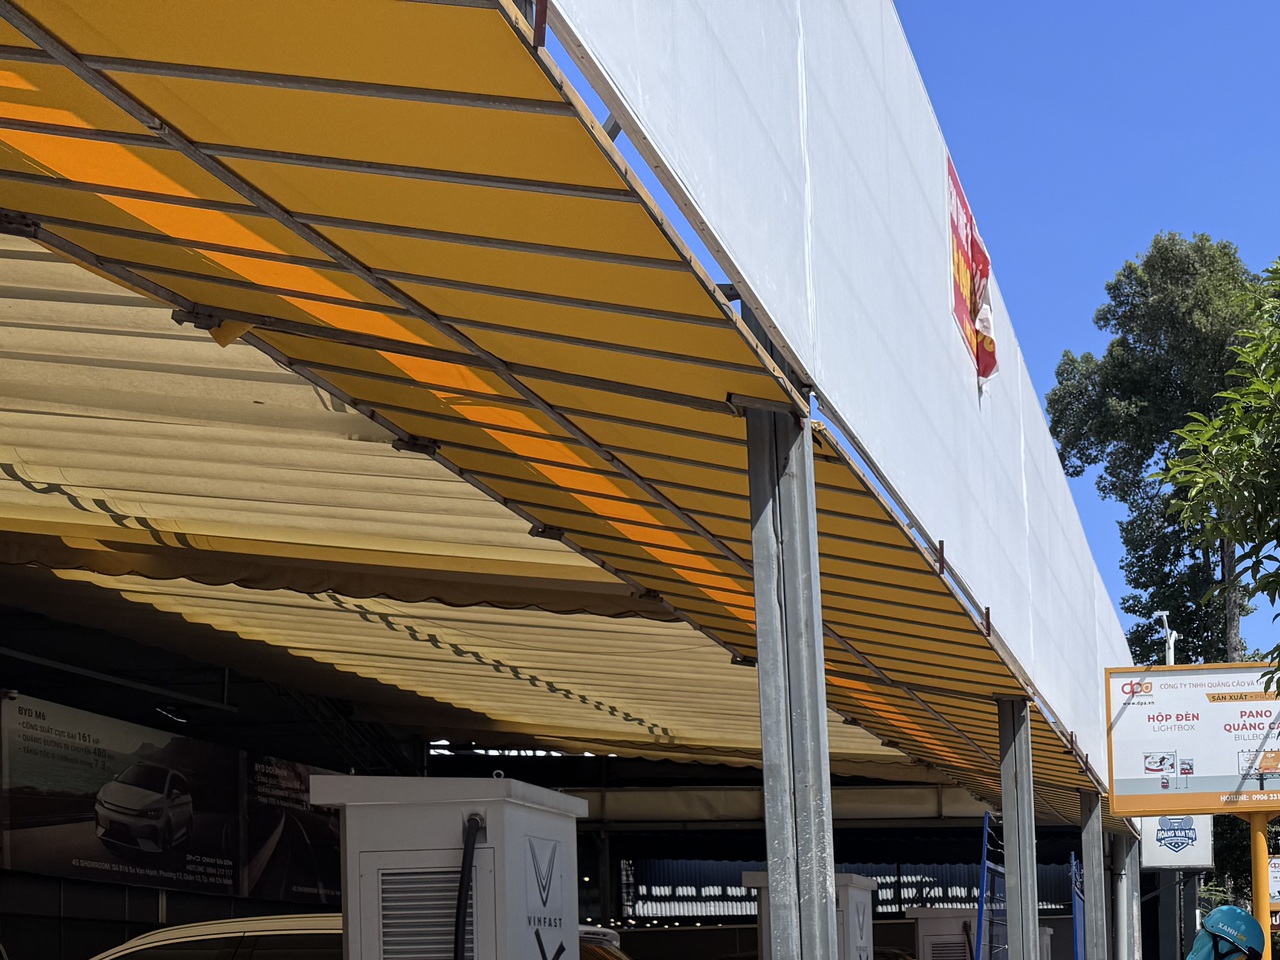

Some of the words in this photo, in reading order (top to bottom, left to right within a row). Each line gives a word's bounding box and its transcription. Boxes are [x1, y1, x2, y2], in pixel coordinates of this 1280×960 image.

[1121, 680, 1152, 698] dpa
[1160, 681, 1178, 690] CÔNG
[1207, 680, 1230, 689] QUẢNG
[1212, 692, 1226, 702] SẢN
[1229, 692, 1247, 701] XUẤT
[18, 706, 32, 717] BYD
[35, 710, 46, 720] M6
[1147, 711, 1172, 725] HỘP
[1175, 710, 1200, 722] ĐÈN
[1240, 710, 1272, 719] PANO
[1153, 724, 1196, 732] LIGHTBOX
[78, 732, 91, 743] 161
[92, 748, 106, 758] 480
[528, 916, 562, 928] VINFAST
[1218, 922, 1238, 936] XANH
